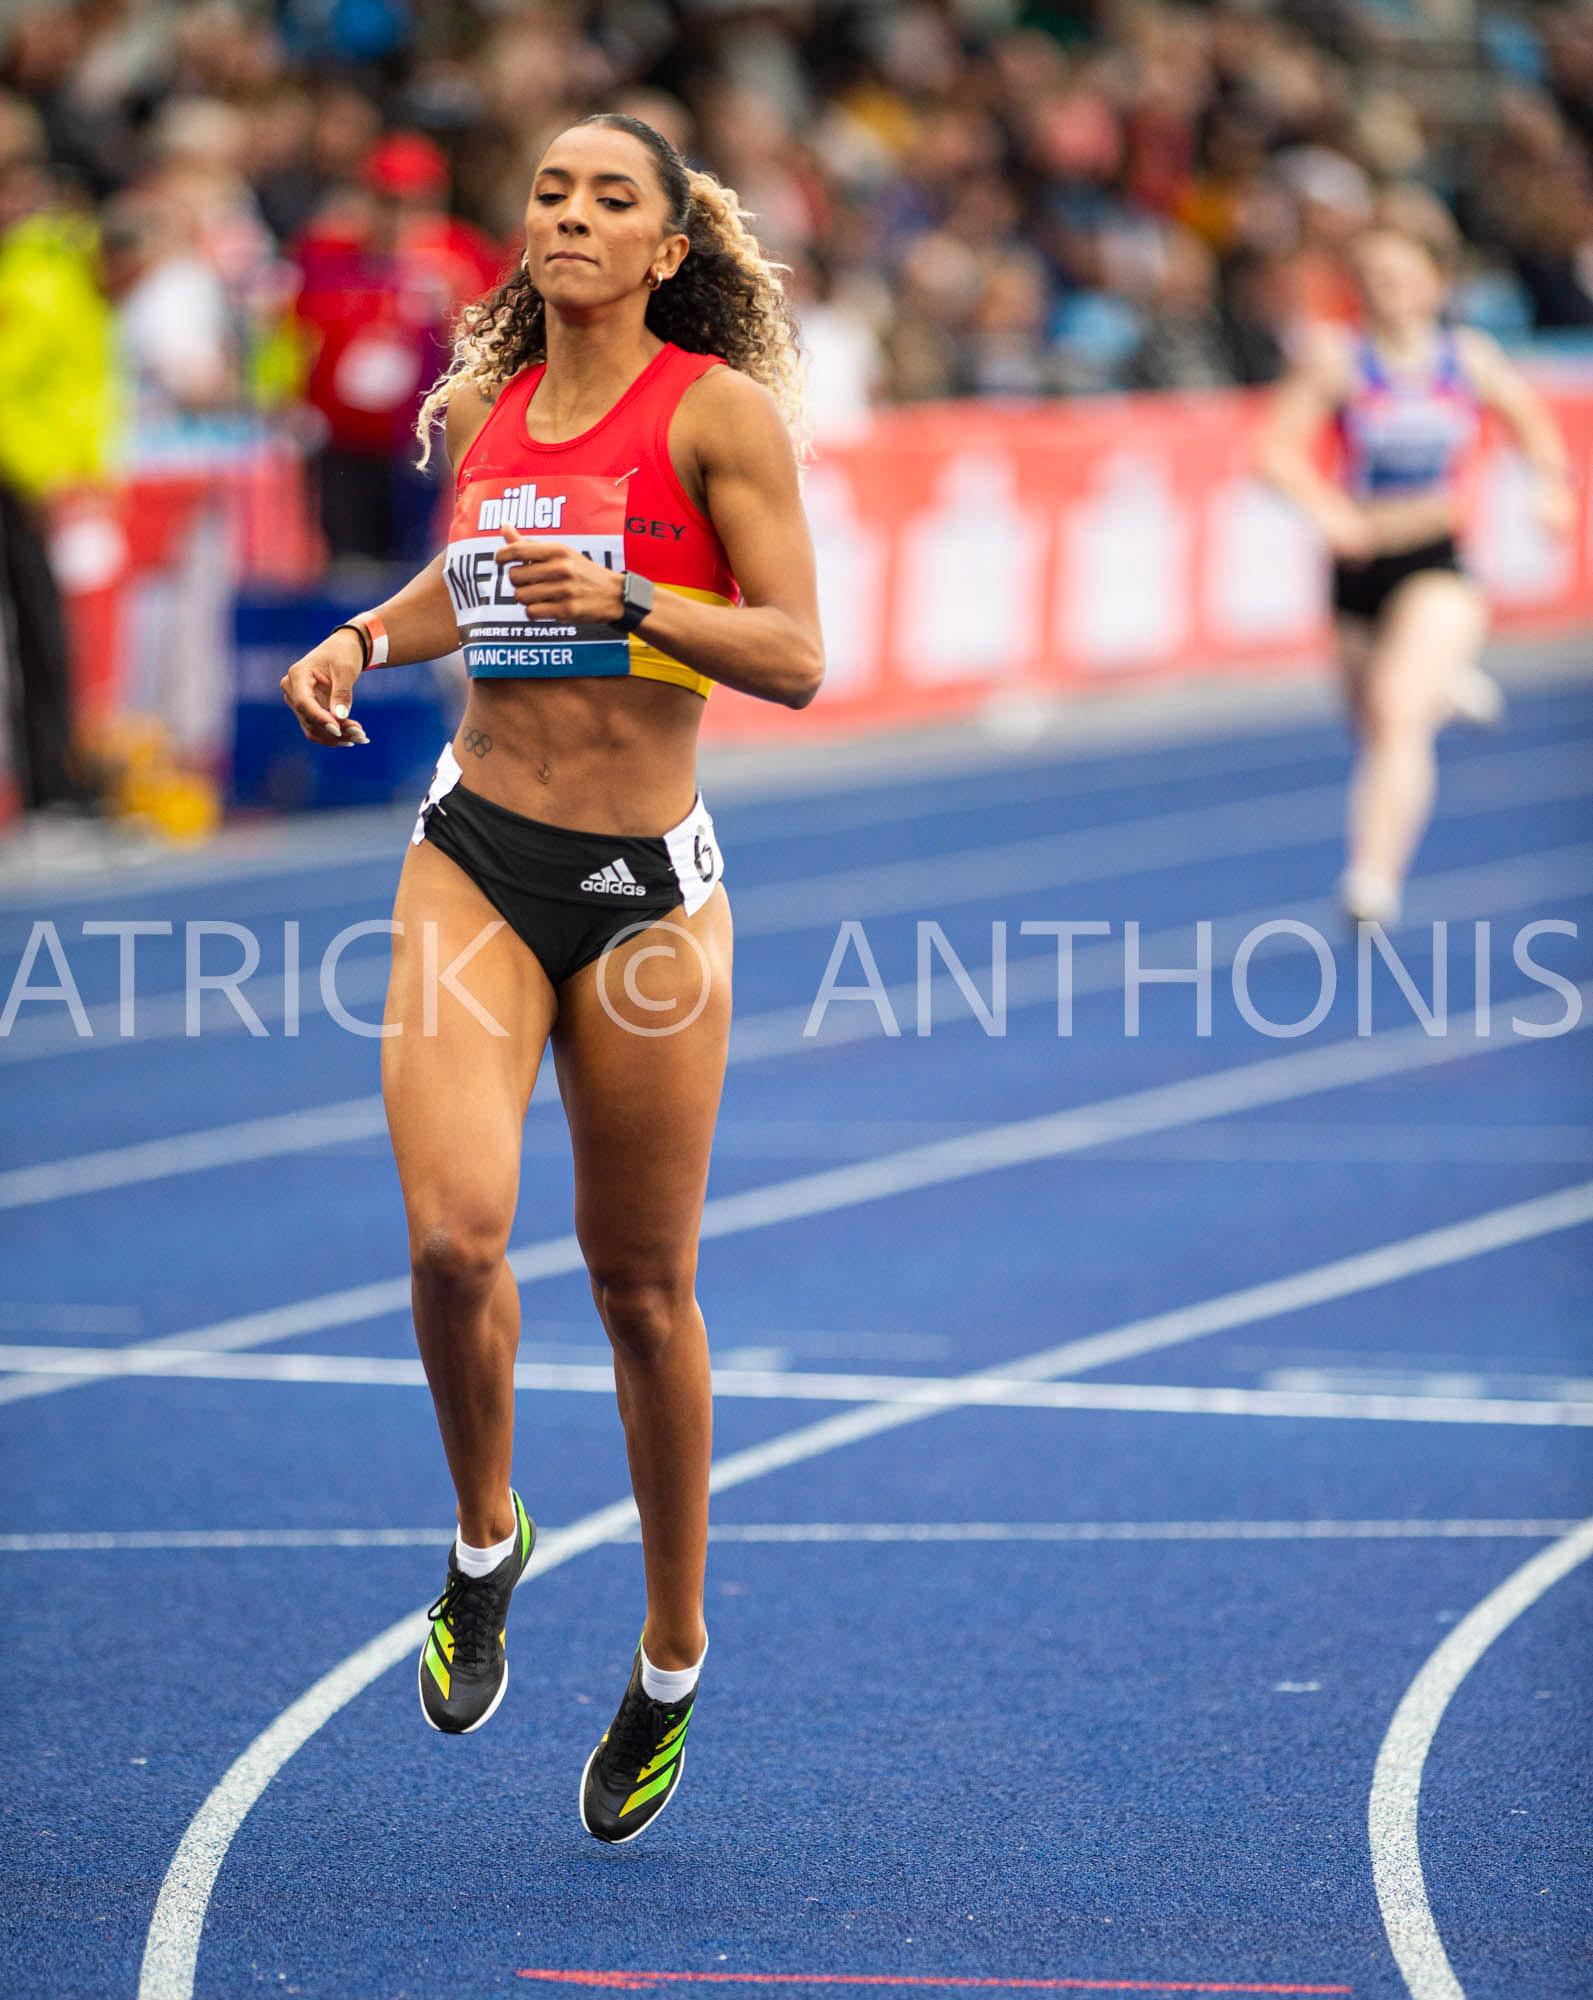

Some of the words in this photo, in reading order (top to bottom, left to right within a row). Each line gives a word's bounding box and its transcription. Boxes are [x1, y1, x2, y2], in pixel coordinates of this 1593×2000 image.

[478, 484, 566, 530] müller
[511, 626, 522, 636] IT
[524, 626, 577, 637] STARTS
[469, 648, 573, 666] MANCHESTER
[694, 825, 714, 883] 6
[579, 879, 647, 897] adidas
